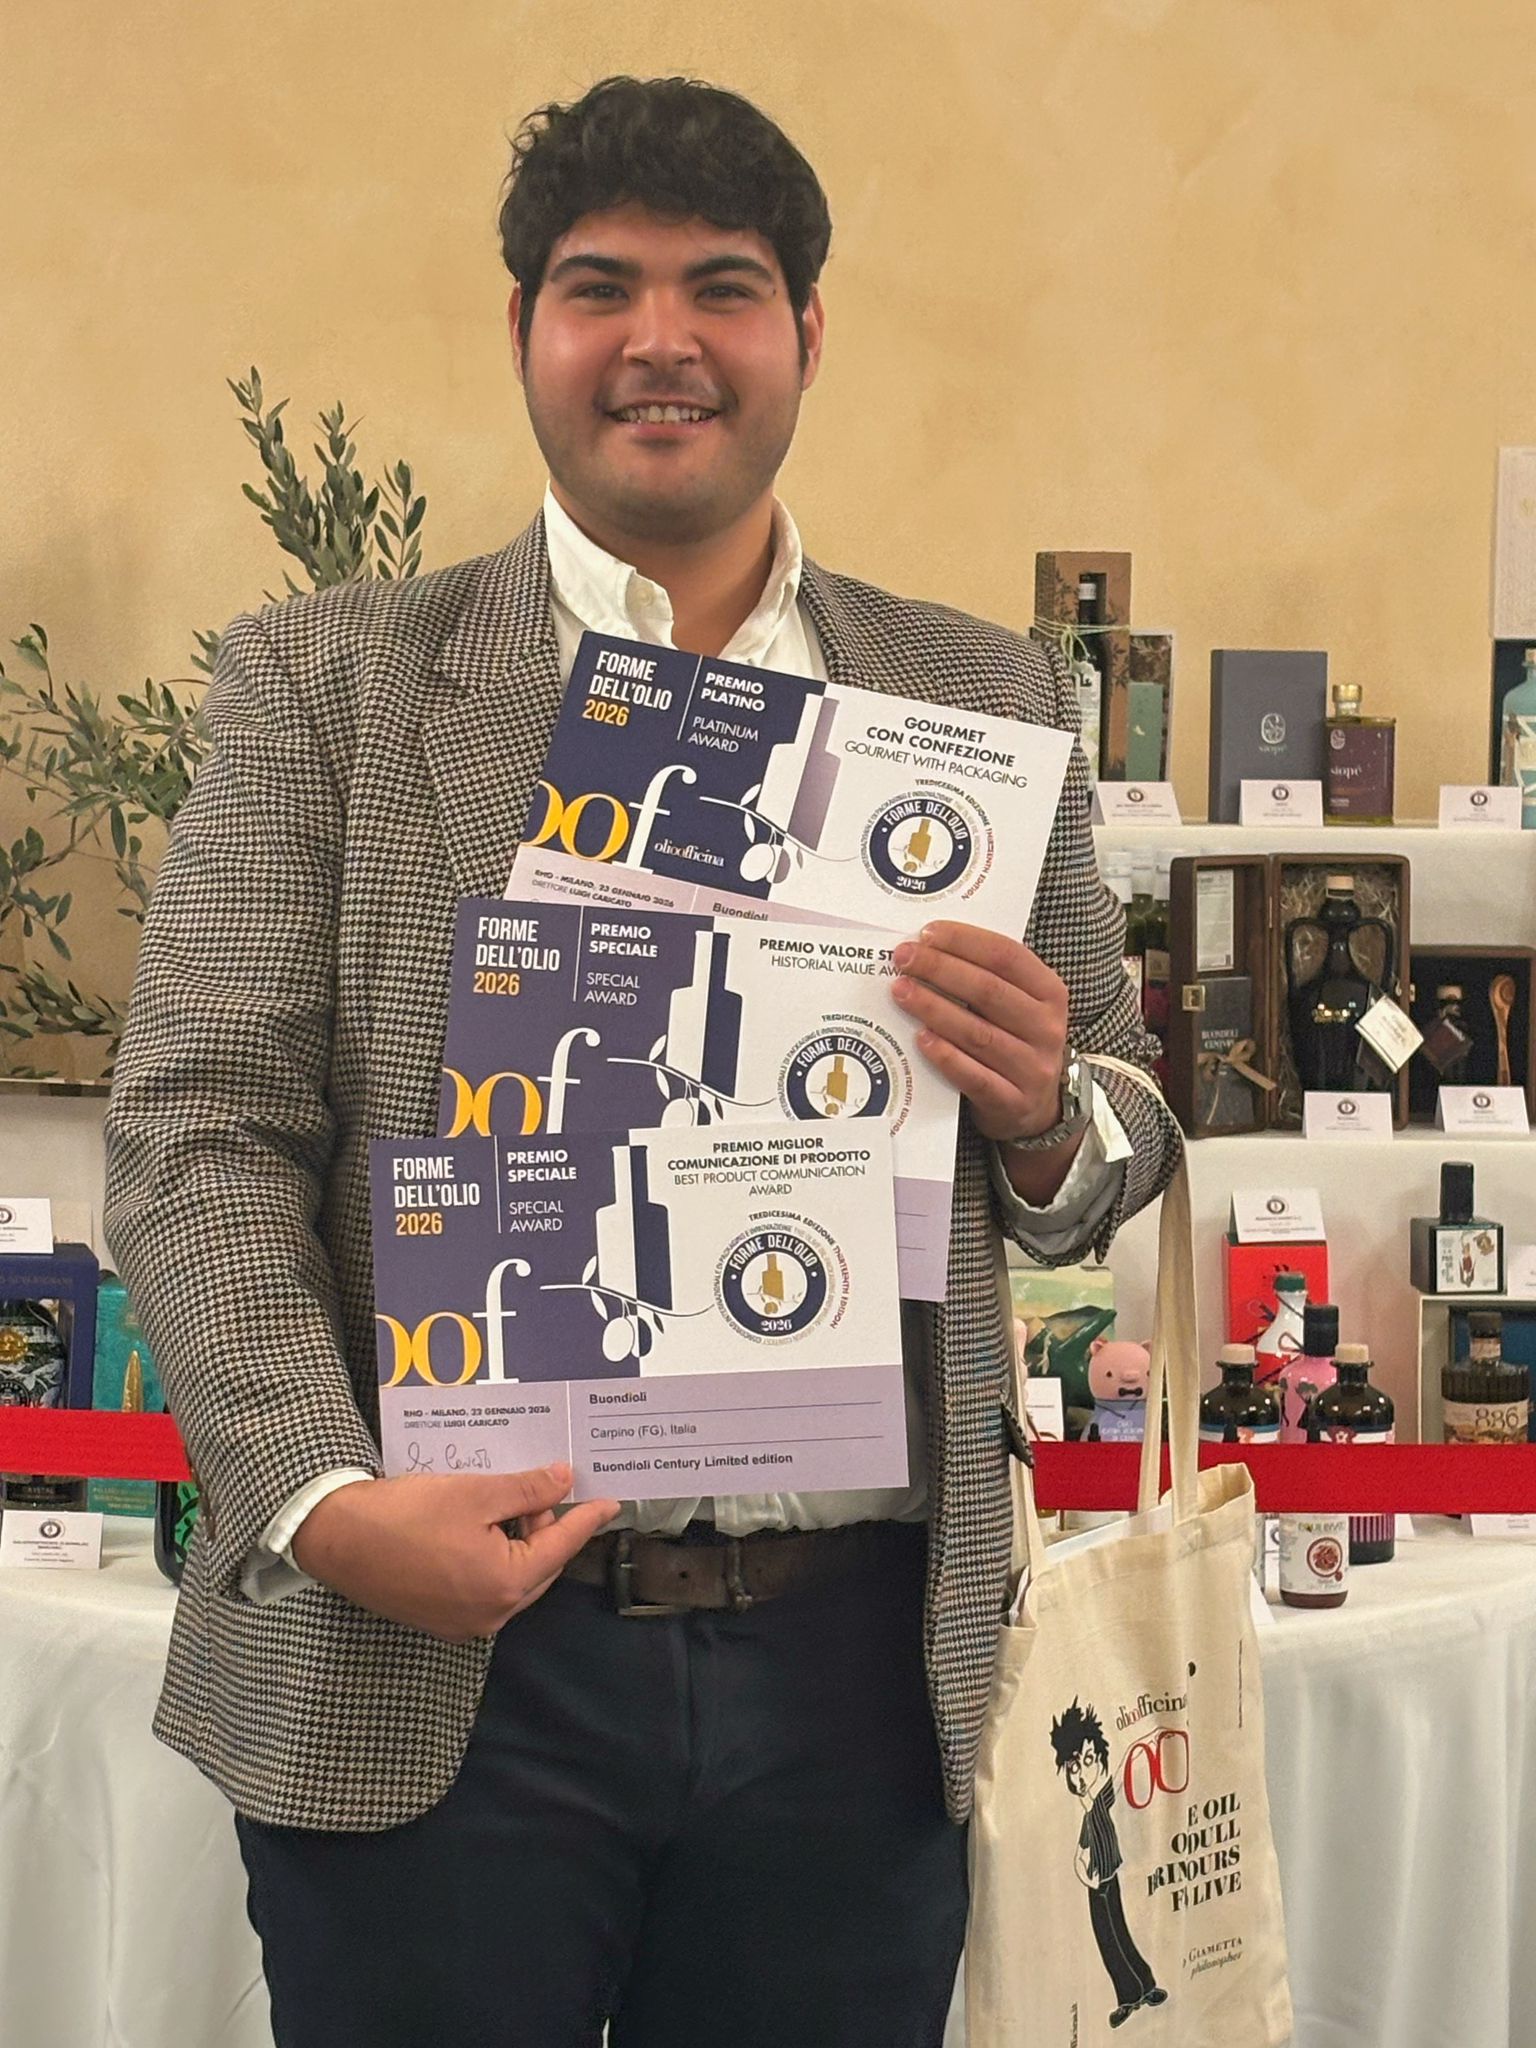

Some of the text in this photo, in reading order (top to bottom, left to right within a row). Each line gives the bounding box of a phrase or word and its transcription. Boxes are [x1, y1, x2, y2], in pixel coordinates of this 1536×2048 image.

[596, 650, 657, 681] FORME
[588, 674, 672, 710] DELL'OLIO
[705, 672, 764, 695] PREMIO
[701, 688, 765, 712] PLATINO
[582, 700, 630, 727] 2026
[692, 716, 758, 741] PLATINUM
[904, 716, 986, 743] GOURMET
[688, 732, 739, 753] AWARD
[866, 726, 1015, 768] CON CONFEZIONE
[845, 740, 1027, 788] GOURMET WITH PACKAGING
[883, 800, 968, 840] FORME DELL'OLIO
[477, 917, 539, 942] FORME
[591, 923, 651, 940] PREMIO
[475, 944, 561, 971] DELL'OLIO
[589, 941, 658, 958] SPECIALE
[759, 938, 814, 954] PREMIO
[819, 943, 874, 960] VALORE
[771, 955, 834, 972] HISTORIAL
[837, 962, 876, 976] VALUE
[473, 971, 520, 996] 2026
[586, 972, 640, 989] SPECIAL
[584, 990, 637, 1006] AWARD
[796, 1037, 884, 1074] FORME DELL'OLIO
[713, 1137, 824, 1153] PREMIO MIGLIOR
[393, 1156, 455, 1180] FORME
[507, 1149, 569, 1165] PREMIO
[668, 1150, 871, 1171] COMUNICAZIONE DI PRODOTTO
[507, 1167, 577, 1183] SPECIALE
[674, 1165, 866, 1185] BEST PRODUCT COMMUNICATION
[394, 1183, 480, 1208] DELL'OLIO
[749, 1184, 793, 1196] AWARD
[509, 1200, 564, 1215] SPECIAL
[395, 1212, 444, 1236] 2026
[509, 1218, 562, 1233] AWARD
[729, 1234, 818, 1271] FORME DELL'OLIO
[589, 1392, 647, 1405] Buondioli
[468, 1419, 509, 1427] CARICATO
[591, 1426, 635, 1440] Carpino
[670, 1424, 697, 1435] Italia
[593, 1453, 793, 1473] Buondioli Century Limited edition
[1203, 1792, 1241, 1820] OIL
